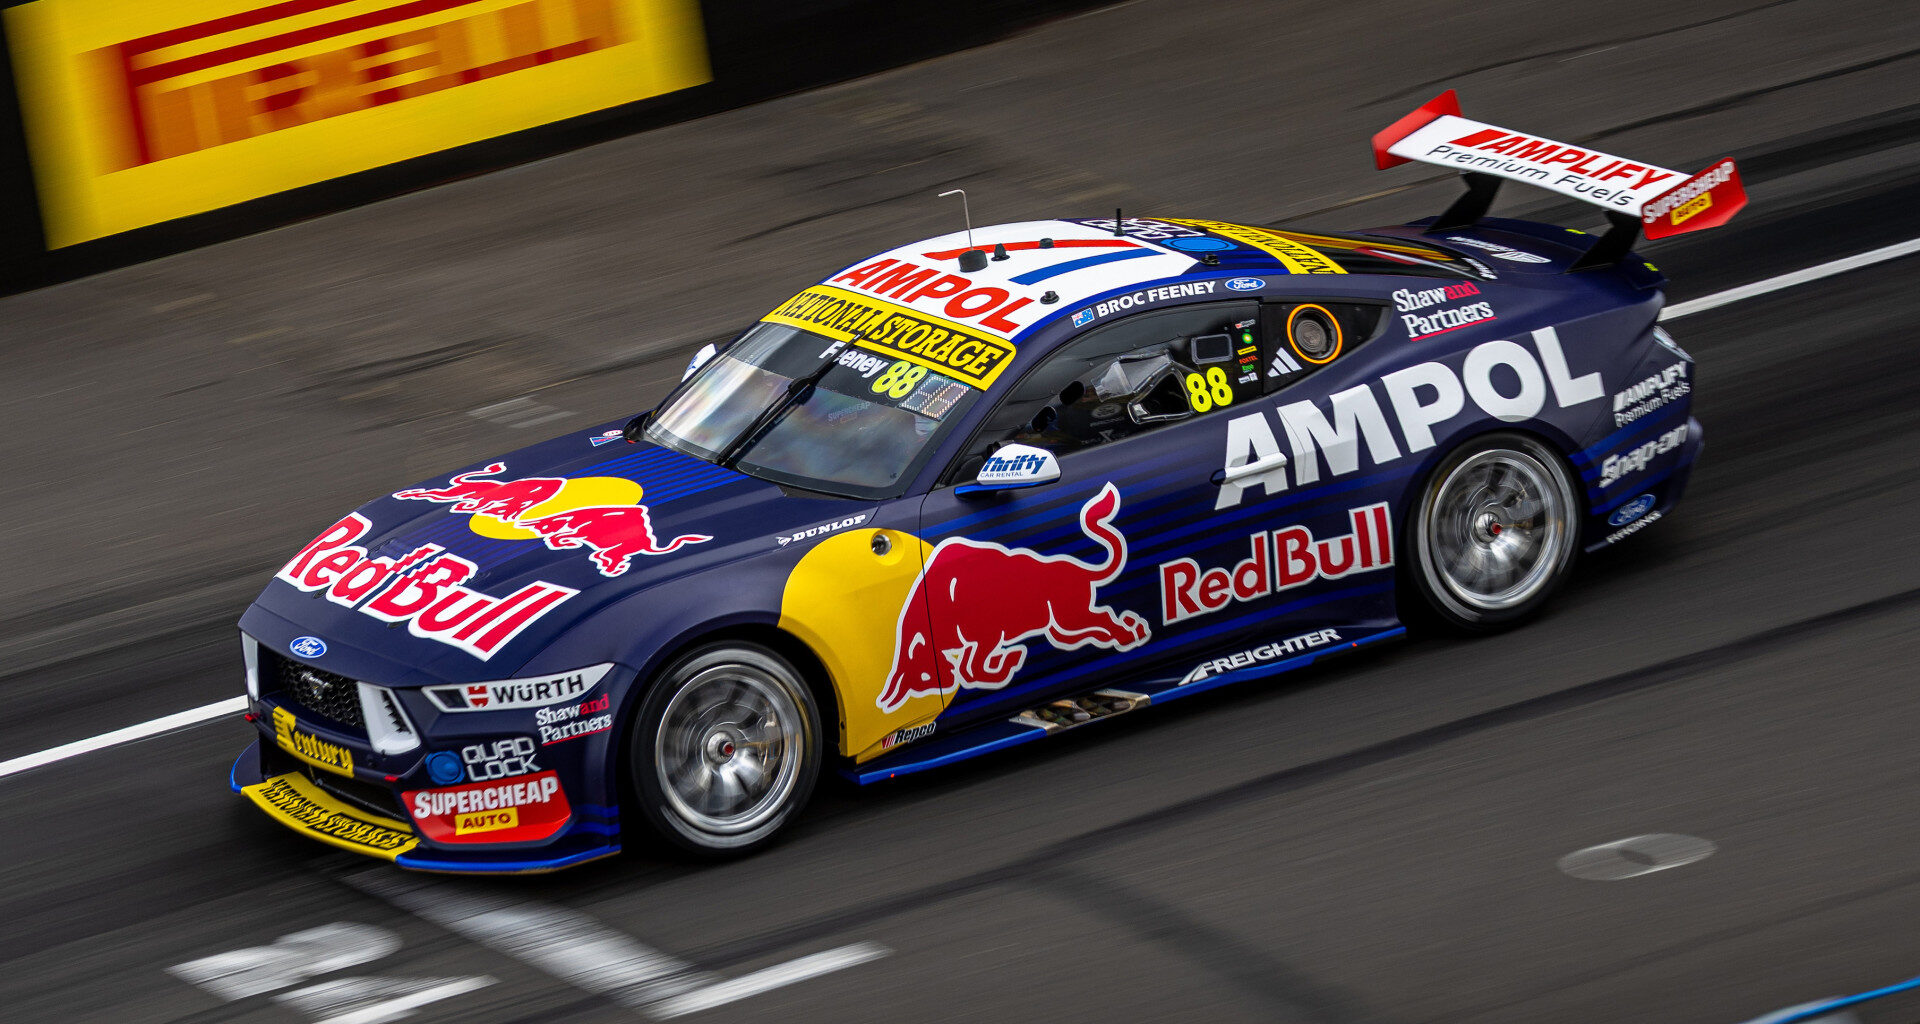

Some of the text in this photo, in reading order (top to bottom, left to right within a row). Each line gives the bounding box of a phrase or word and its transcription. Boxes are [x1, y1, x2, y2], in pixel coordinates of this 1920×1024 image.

[1427, 145, 1636, 206] Premium Fuels
[1476, 129, 1674, 190] AMPLIFY
[832, 258, 1035, 334] AMPOL
[1096, 280, 1217, 318] BROC FEENEY
[1229, 278, 1262, 291] Ford
[776, 292, 1005, 377] NATIONAL STORAGE
[1401, 301, 1494, 338] Partners
[871, 360, 930, 399] 88
[1186, 366, 1233, 412] 88
[1214, 326, 1606, 510] AMPOL
[982, 454, 1048, 475] Thrifty
[792, 514, 866, 542] DUNLOP
[1159, 501, 1394, 626] Red Bull
[276, 511, 580, 662] Red Bull
[1187, 628, 1343, 684] FREIGHTER
[538, 713, 613, 745] Partners
[893, 721, 936, 744] Repco
[461, 736, 536, 765] QUAD
[466, 753, 542, 782] LOCK
[413, 776, 559, 819] SUPERCHEAP
[462, 811, 511, 829] AUTO
